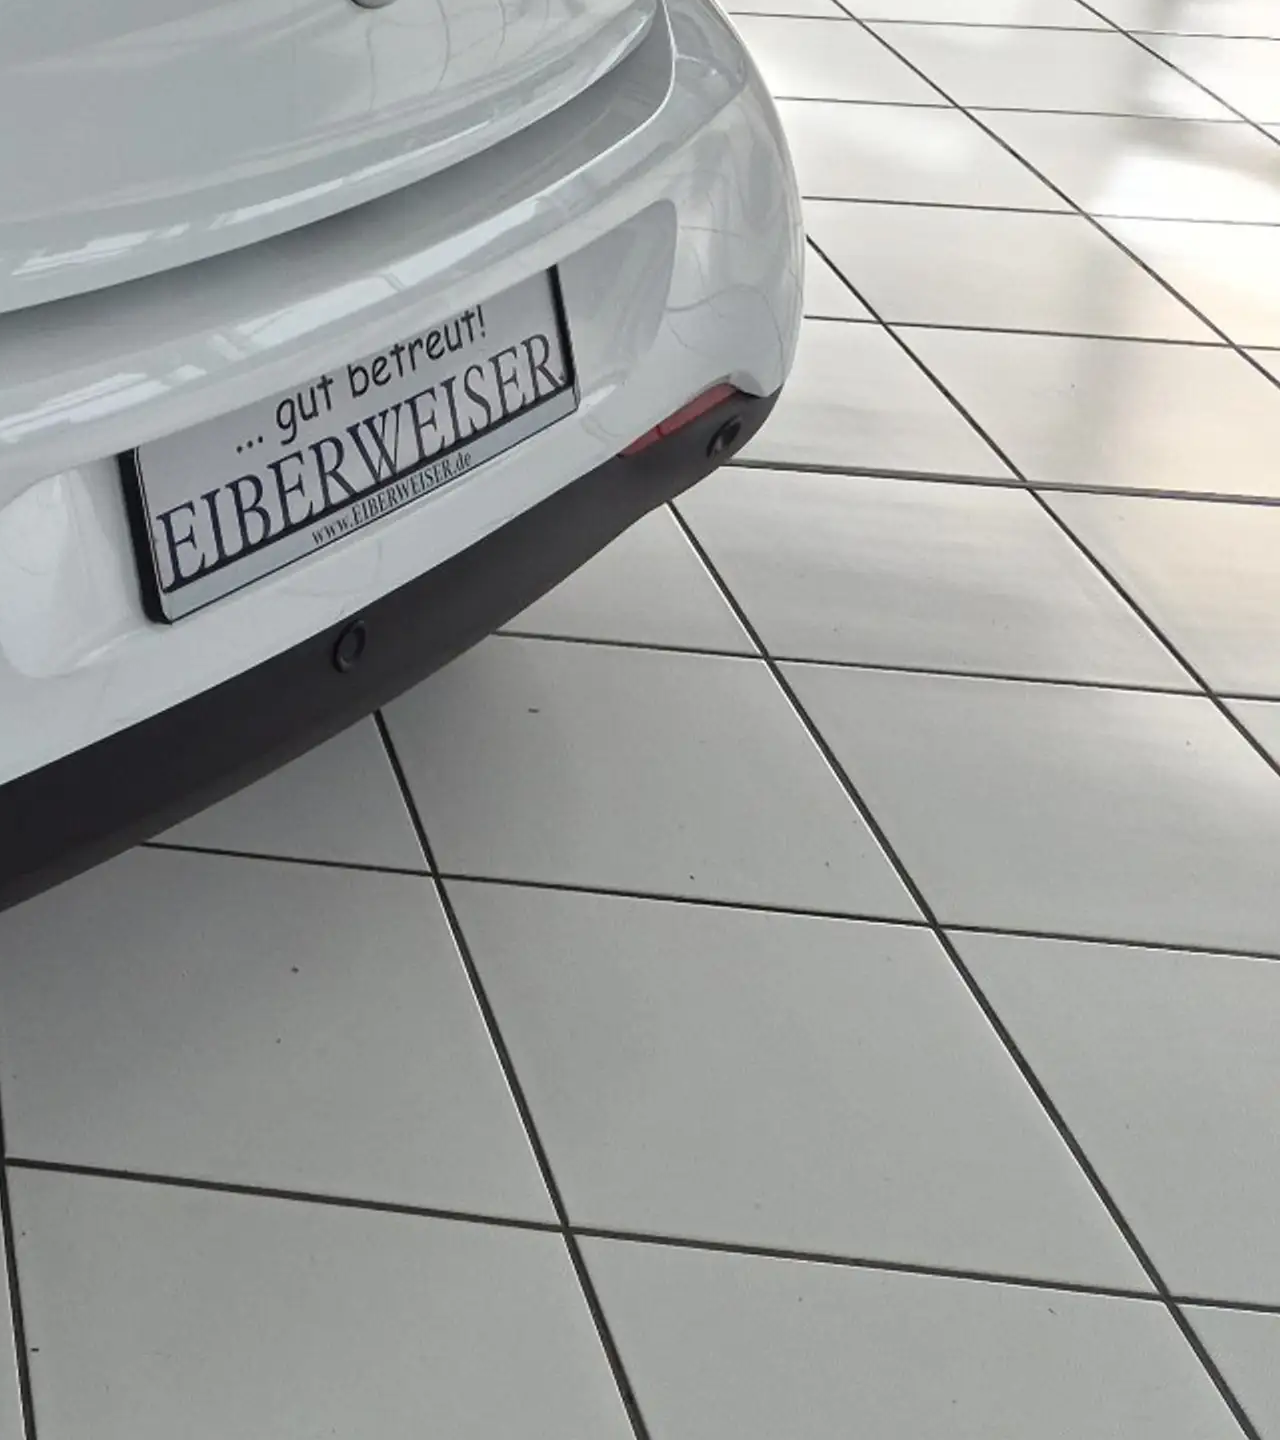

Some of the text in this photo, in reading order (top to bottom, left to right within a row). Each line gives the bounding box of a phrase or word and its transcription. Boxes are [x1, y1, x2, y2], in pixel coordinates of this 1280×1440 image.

[276, 374, 335, 446] gut
[346, 304, 488, 399] betreut!
[155, 332, 568, 590] EIBERWEISER
[311, 451, 473, 547] www.EIBERWEISER.de
